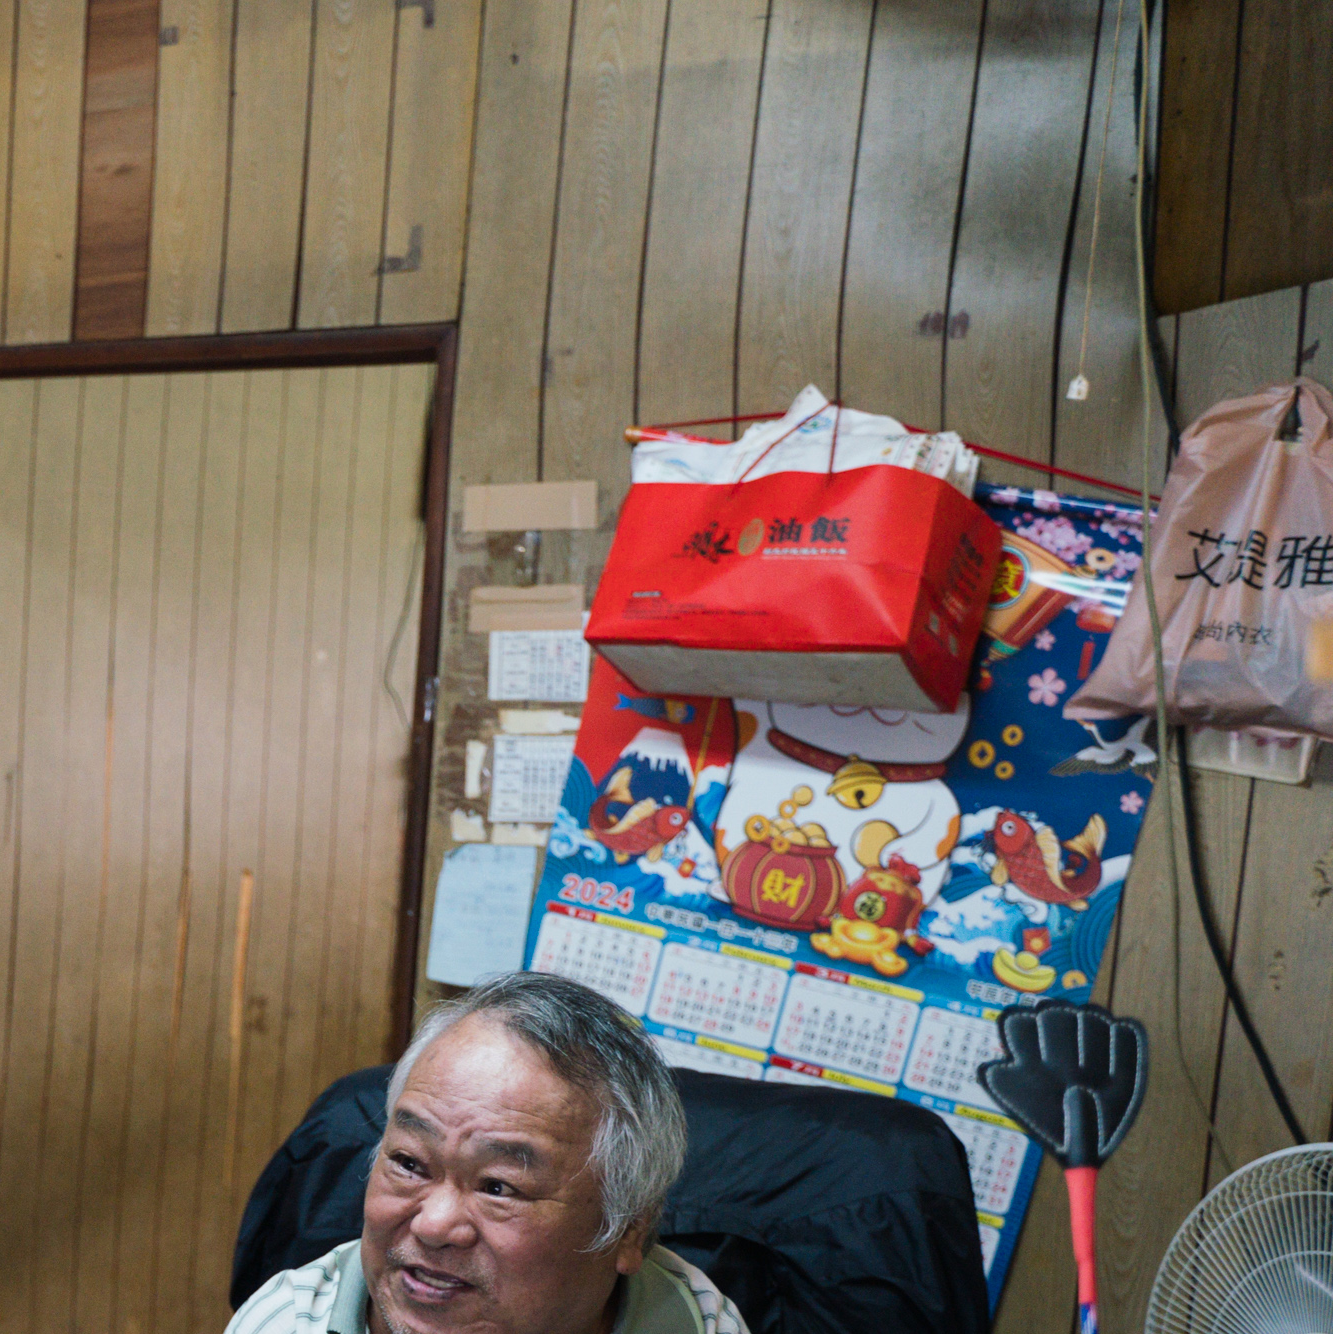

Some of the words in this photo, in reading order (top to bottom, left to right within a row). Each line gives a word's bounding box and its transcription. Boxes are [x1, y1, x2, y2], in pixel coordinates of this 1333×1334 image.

[768, 516, 852, 544] 油飯
[559, 873, 635, 914] 2024
[761, 867, 806, 908] 財
